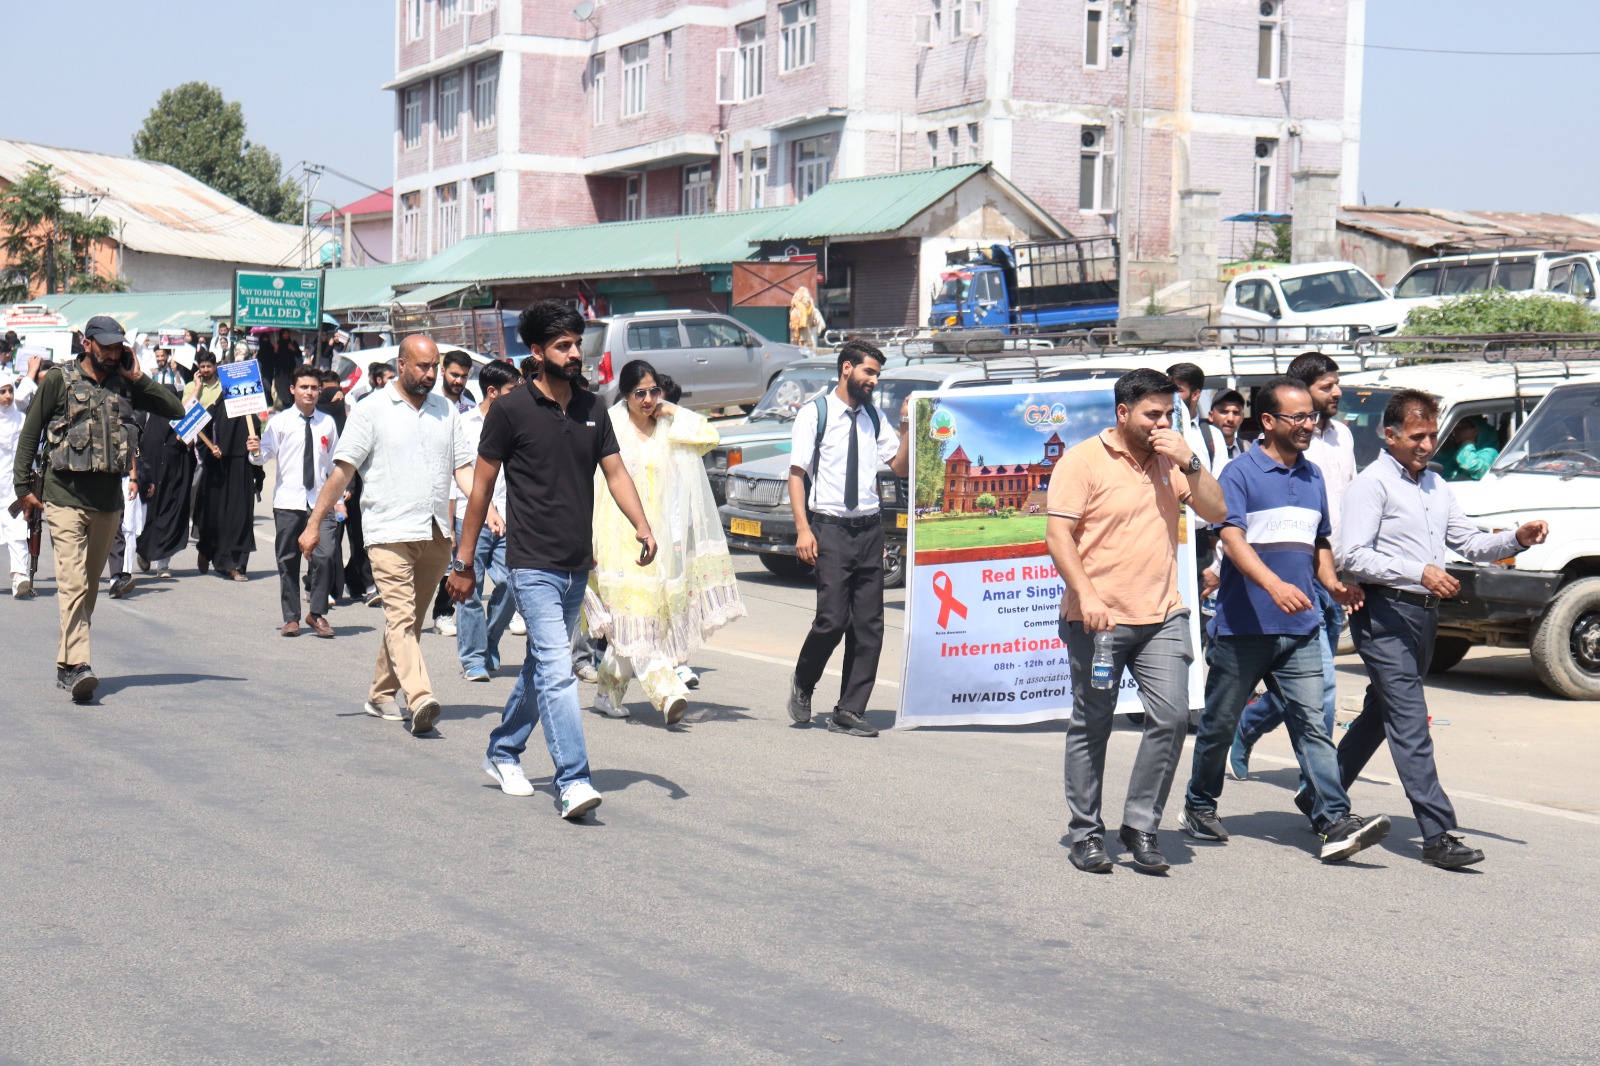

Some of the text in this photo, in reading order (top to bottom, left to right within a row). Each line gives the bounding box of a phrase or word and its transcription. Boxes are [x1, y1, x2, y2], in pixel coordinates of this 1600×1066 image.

[240, 288, 252, 296] WAY
[282, 290, 316, 299] TRANSPORT
[246, 297, 283, 306] TERMINAL
[285, 299, 297, 307] NO.
[254, 307, 301, 318] LAL DED
[228, 394, 261, 404] International
[230, 406, 263, 415] Celebrations
[1266, 520, 1282, 531] LEVI
[982, 567, 1015, 583] Red
[982, 584, 1064, 602] Amar Singh
[998, 606, 1029, 614] Cluster
[994, 662, 1015, 671] 08th
[1024, 660, 1044, 669] 12th
[1046, 658, 1055, 666] of
[1014, 677, 1024, 686] In
[951, 692, 1016, 703] HIV/AIDS
[1020, 686, 1065, 701] Control
